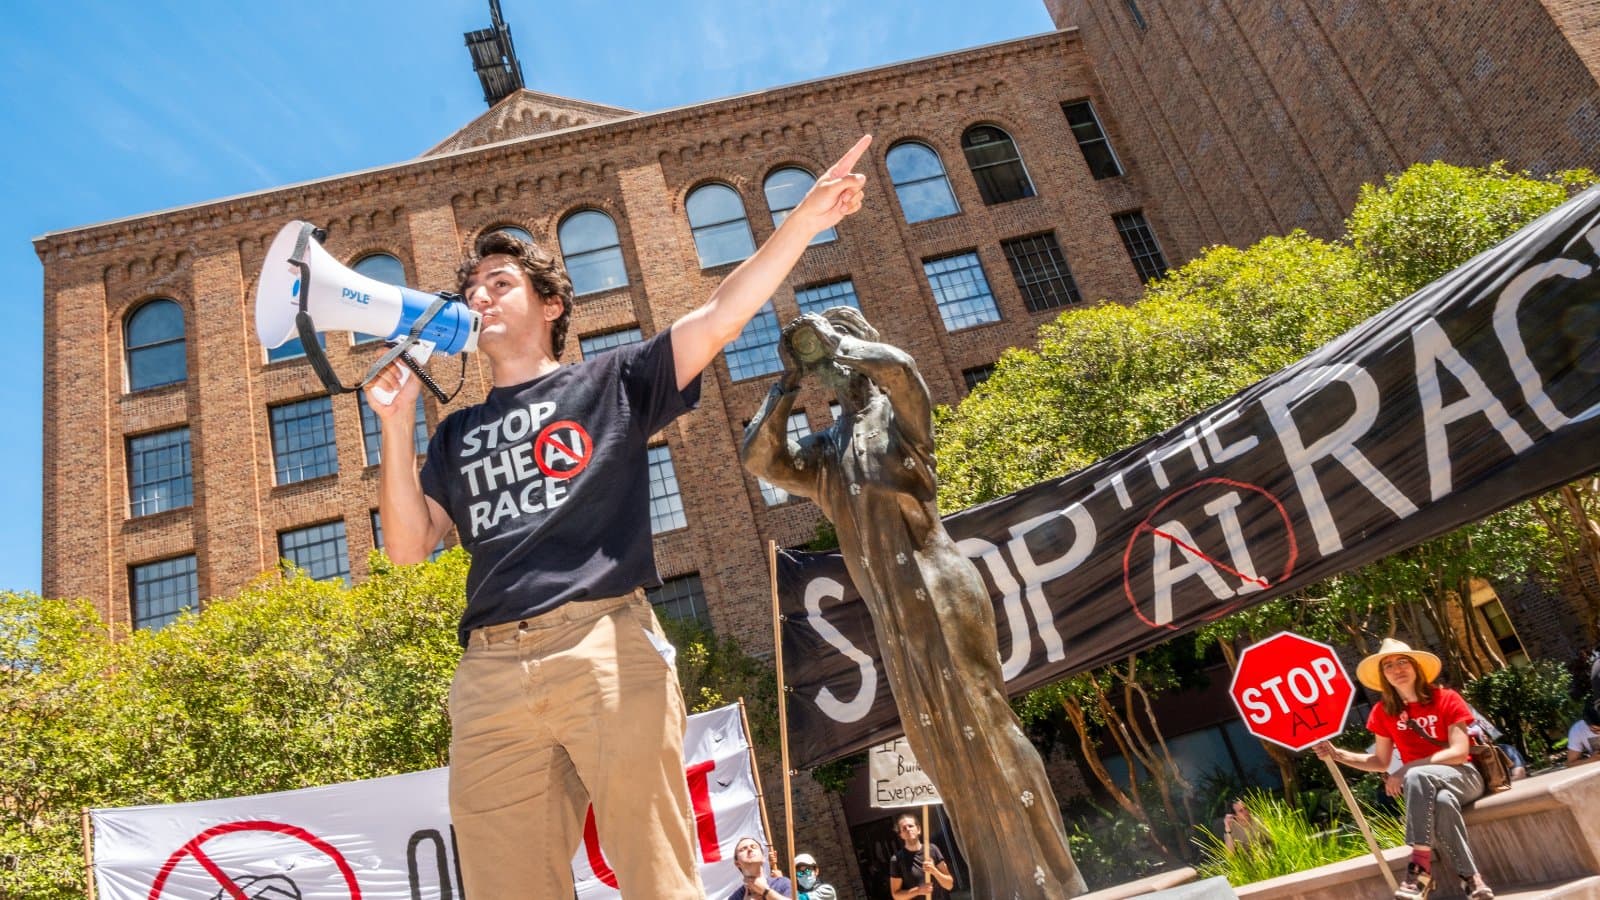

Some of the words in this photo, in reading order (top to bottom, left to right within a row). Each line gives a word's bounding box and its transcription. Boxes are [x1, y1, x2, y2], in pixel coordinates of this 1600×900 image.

[342, 287, 371, 305] PYLE
[1259, 224, 1600, 555] RAC
[460, 400, 557, 458] STOP
[460, 441, 538, 497] THE
[542, 429, 584, 472] AI
[1093, 398, 1259, 510] THE
[468, 478, 570, 537] RACE
[1152, 491, 1269, 625] AI
[804, 502, 1097, 723] SOP
[1241, 656, 1338, 725] STOP
[1290, 703, 1329, 738] AI
[876, 778, 934, 804] Everyone
